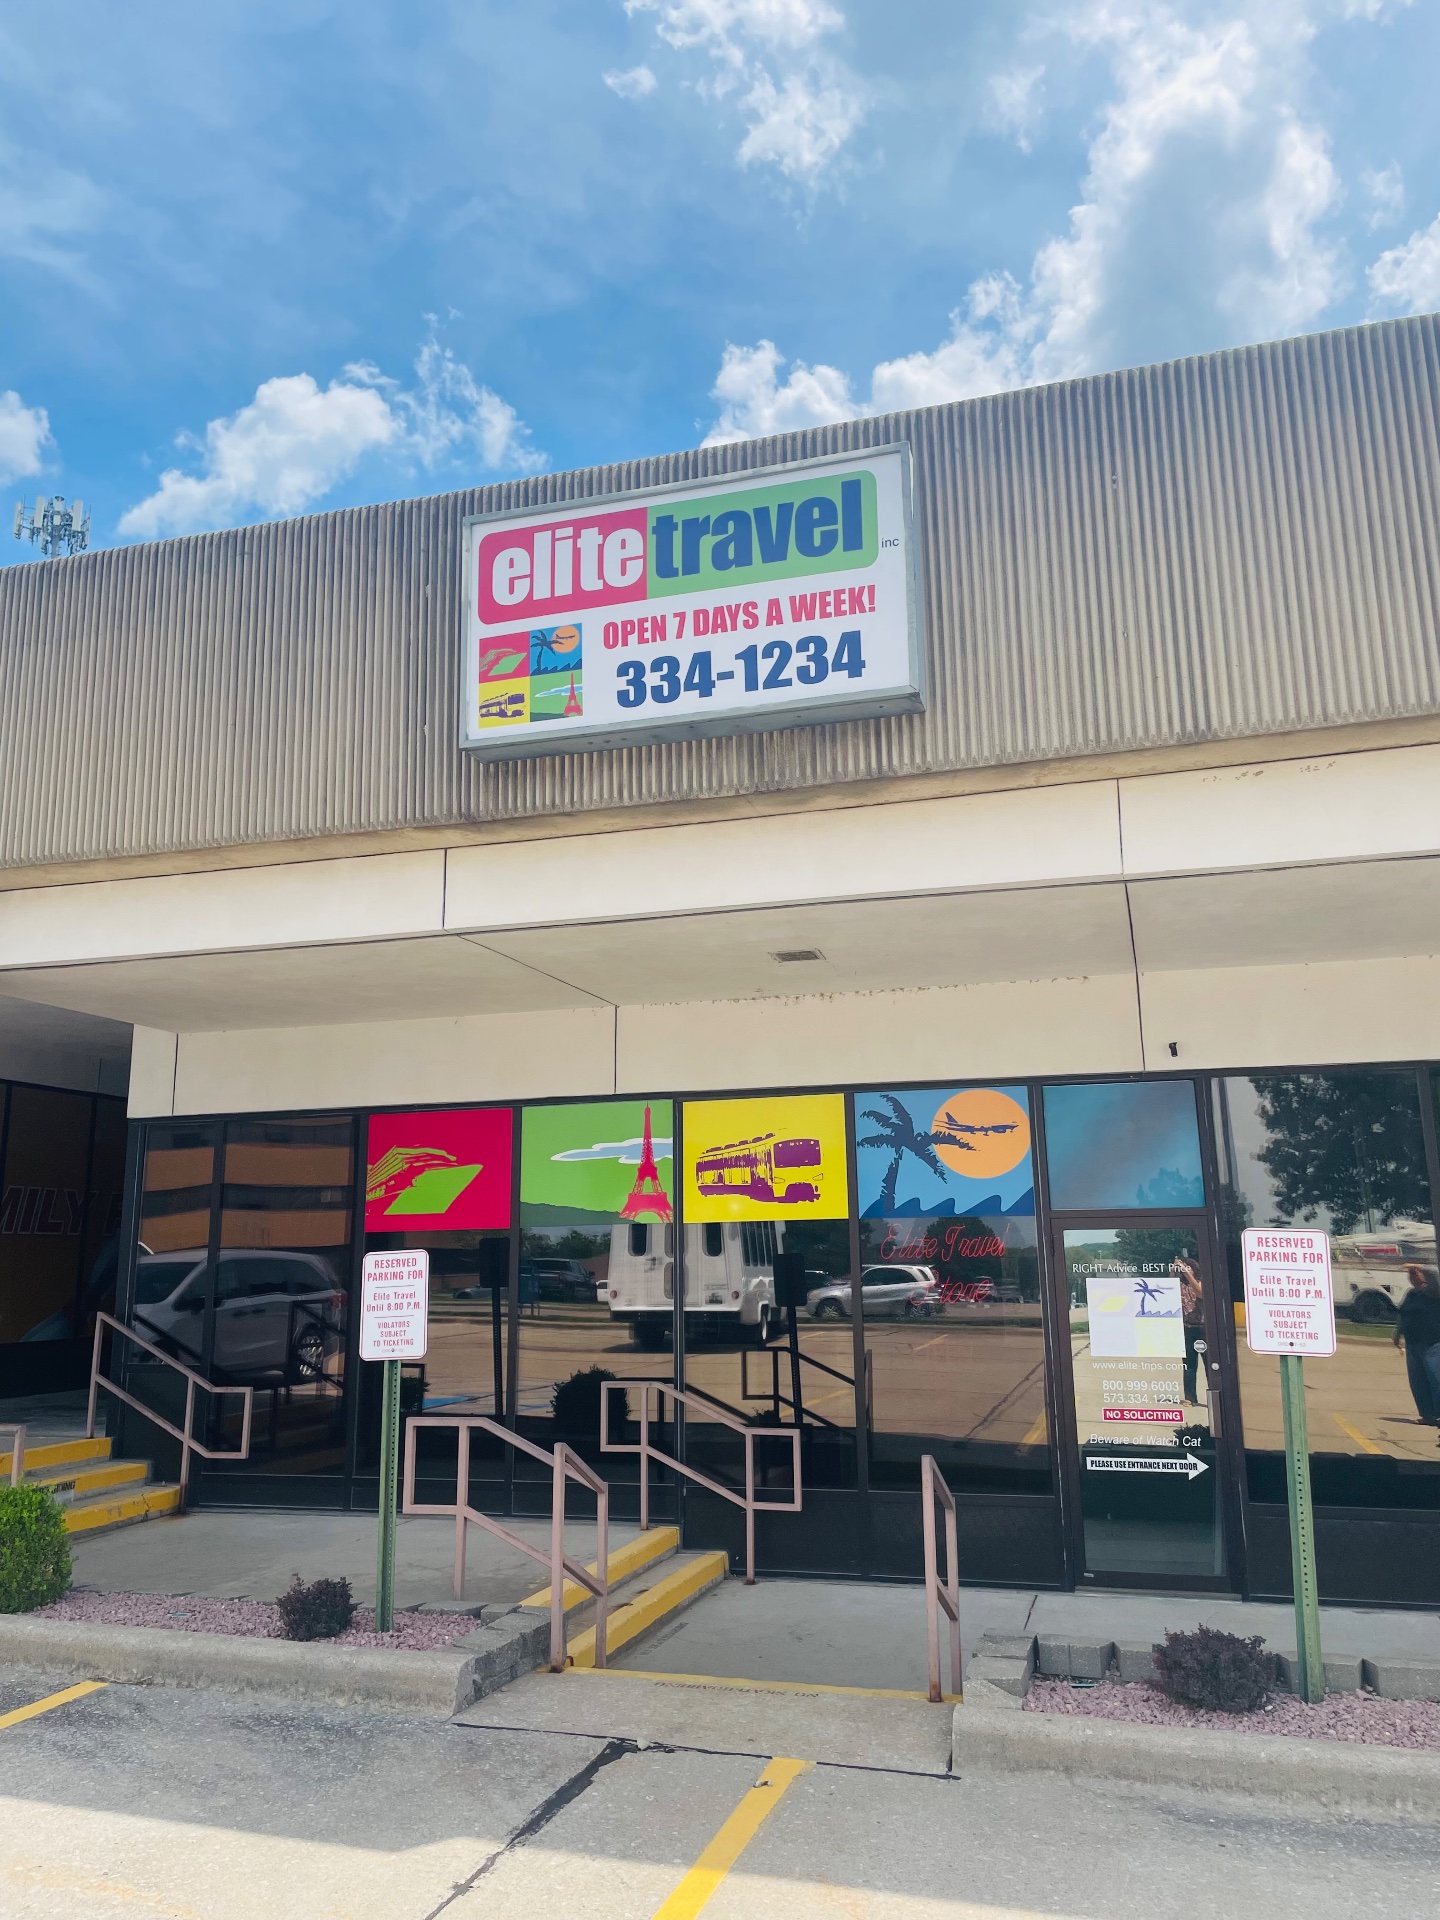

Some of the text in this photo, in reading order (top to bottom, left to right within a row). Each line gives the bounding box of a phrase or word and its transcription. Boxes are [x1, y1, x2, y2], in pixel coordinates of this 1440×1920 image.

[492, 479, 863, 606] elite travel
[881, 537, 899, 549] inc
[603, 585, 876, 650] OPEN 7 DAYS A WEEK!
[616, 631, 866, 708] 334-1234
[880, 1223, 1011, 1262] Elite Travel
[1258, 1237, 1313, 1249] RESERVED
[1250, 1251, 1323, 1264] PARKING FOR
[374, 1258, 417, 1269] RESERVED
[1072, 1263, 1191, 1273] RIGHT Advice BEST Price
[367, 1270, 423, 1282] PARKING FOR
[1260, 1275, 1316, 1286] Elite Travel
[373, 1291, 416, 1301] Elite Travel
[1252, 1287, 1326, 1299] Until 8:00 P.M.
[366, 1302, 422, 1312] Until 8:00 P.M.
[1269, 1309, 1311, 1319] VIOLATORS
[377, 1321, 410, 1329] VIOLATORS
[1274, 1320, 1307, 1329] SUBJECT
[1265, 1330, 1319, 1340] TO TICKETING
[373, 1339, 414, 1347] TO TICKETING
[1092, 1361, 1187, 1371] www.elite-trips.com
[1102, 1380, 1179, 1391] 800.999.6003
[1103, 1393, 1180, 1404] 573.334.1234
[1106, 1410, 1180, 1420] NO SOLICITING
[1090, 1434, 1201, 1447] Beware of Watch Cat
[1090, 1460, 1198, 1470] PLEASE USE ENTRANCE NEXT DOOR
